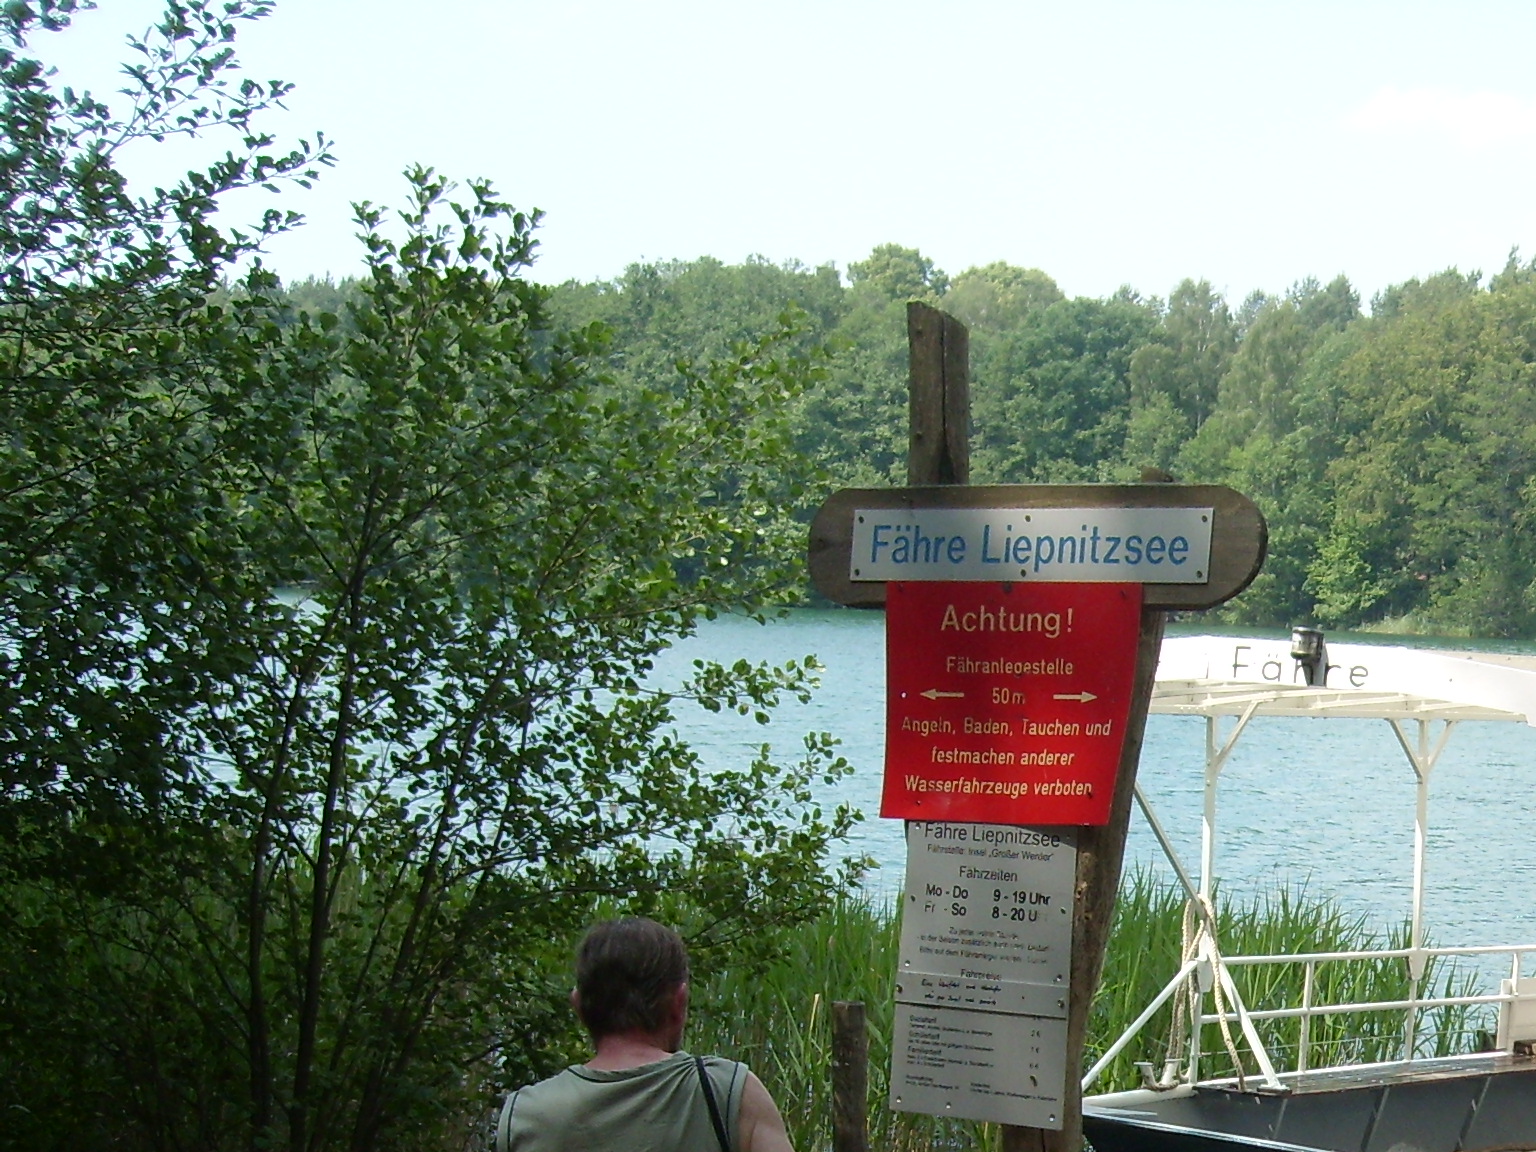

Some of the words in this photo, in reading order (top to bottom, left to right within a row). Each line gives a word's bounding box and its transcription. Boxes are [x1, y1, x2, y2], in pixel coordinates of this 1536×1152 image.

[871, 524, 966, 564] Fähre
[981, 524, 1189, 573] Liepnitzsee
[940, 604, 1073, 639] Achtung!
[946, 656, 1073, 679] Fähranlegestelle
[992, 687, 1010, 705] 50
[1012, 692, 1026, 705] m
[902, 716, 956, 737] Angeln,
[964, 717, 1013, 737] Baden,
[1022, 719, 1079, 736] Tauchen
[1085, 719, 1112, 736] und
[931, 746, 1015, 765] festmachen
[1020, 749, 1075, 766] anderer
[905, 775, 1028, 800] Wasserfahrzeuge
[1033, 780, 1092, 797] verboten
[972, 825, 1061, 848] Liepnitzsee
[959, 866, 1018, 883] Fahrzeiten
[925, 884, 943, 897] Mo
[952, 885, 969, 900] Do
[993, 889, 1001, 902] 9
[1012, 890, 1027, 904] 19
[1029, 891, 1051, 906] Uhr
[951, 903, 967, 917] So
[991, 906, 1000, 919] 8
[1010, 907, 1026, 922] 20
